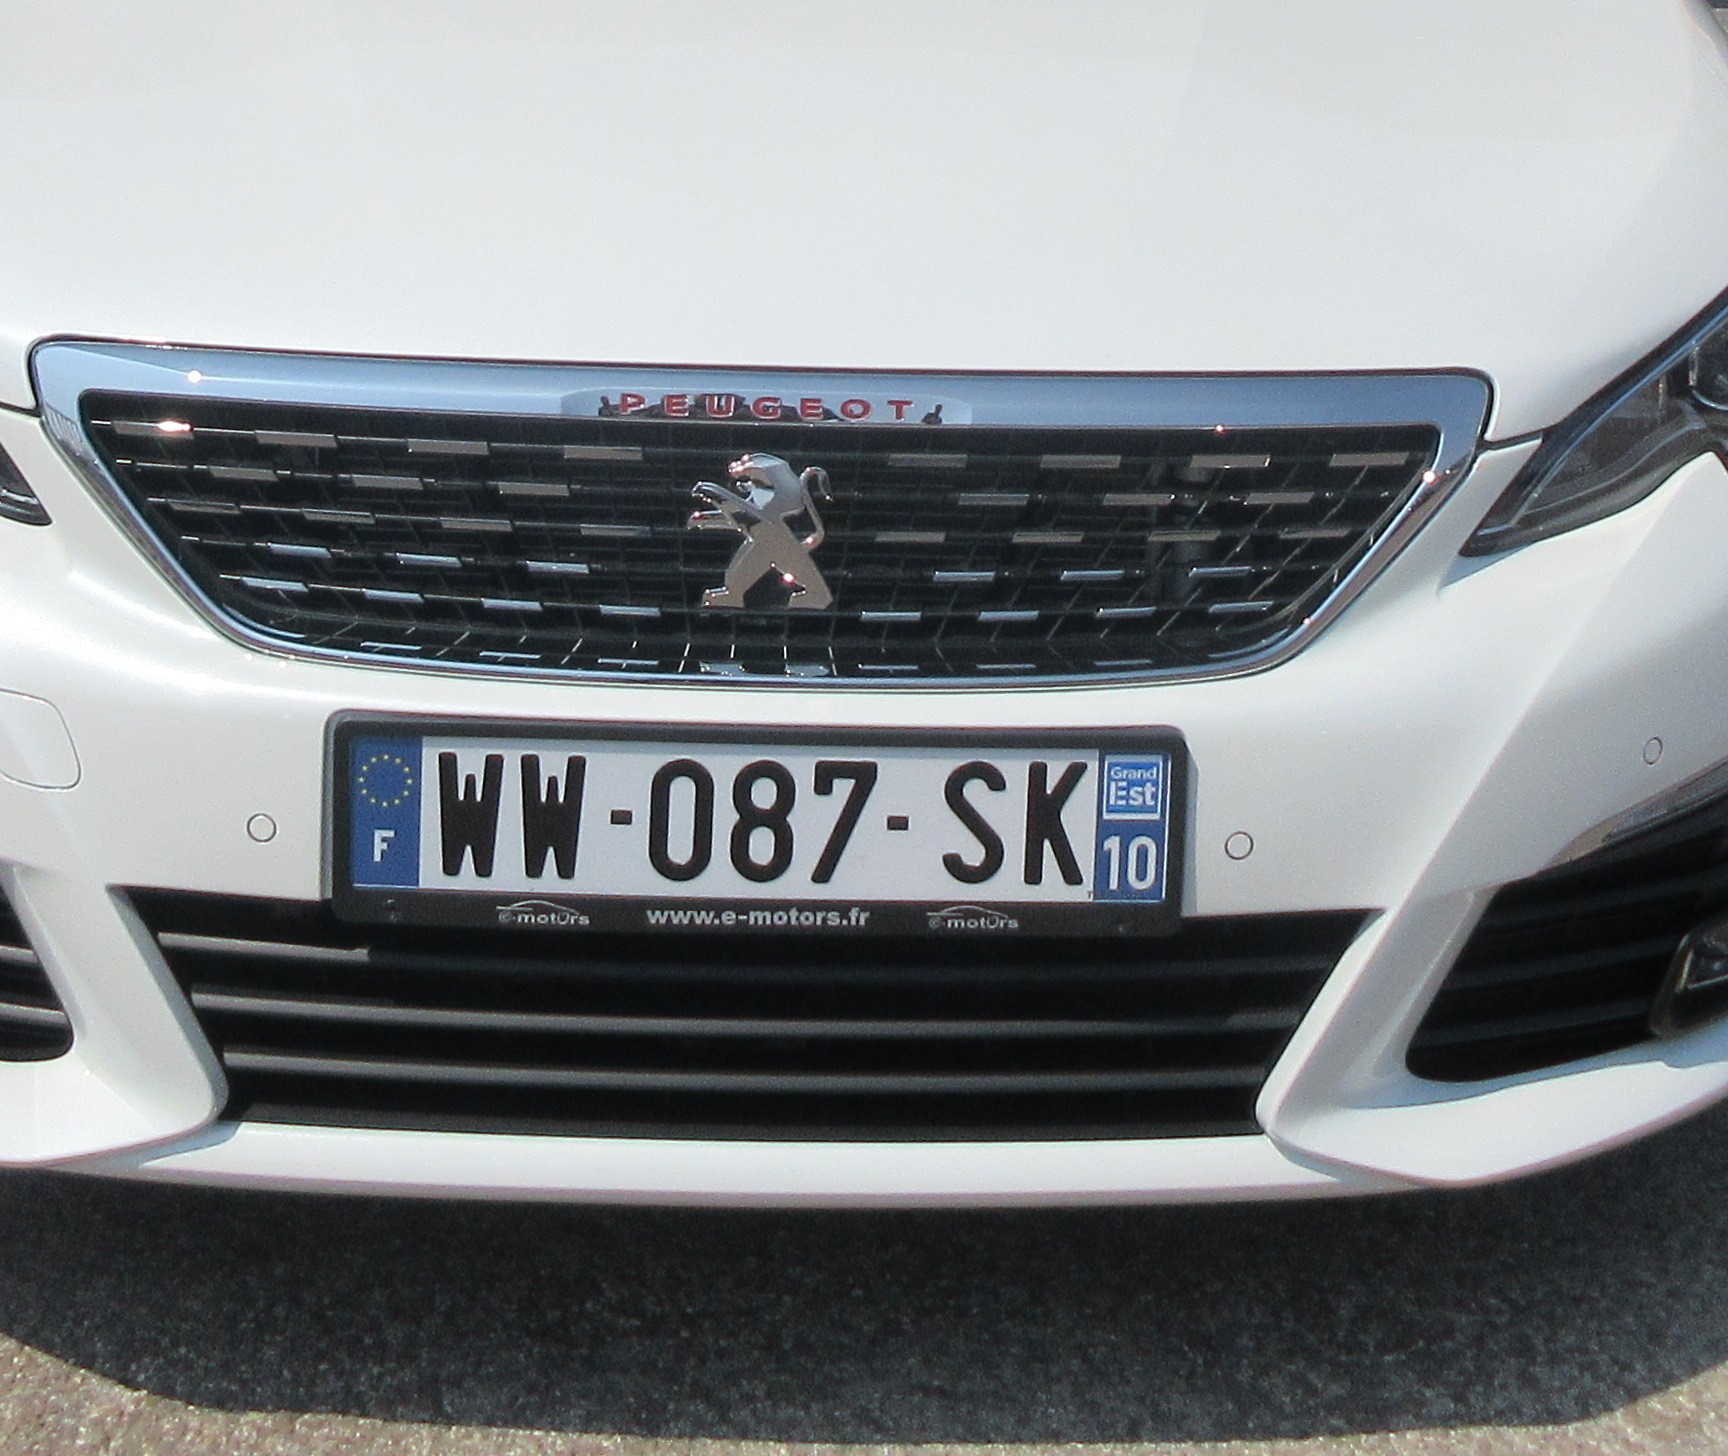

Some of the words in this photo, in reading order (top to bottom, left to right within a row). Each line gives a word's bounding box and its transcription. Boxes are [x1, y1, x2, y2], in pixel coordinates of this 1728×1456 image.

[618, 392, 913, 421] PEUGEOT
[1110, 766, 1157, 780] Grand
[1109, 780, 1156, 806] Est
[373, 828, 396, 863] F
[1103, 835, 1157, 891] 10
[646, 906, 870, 926] www.e-motors.fr
